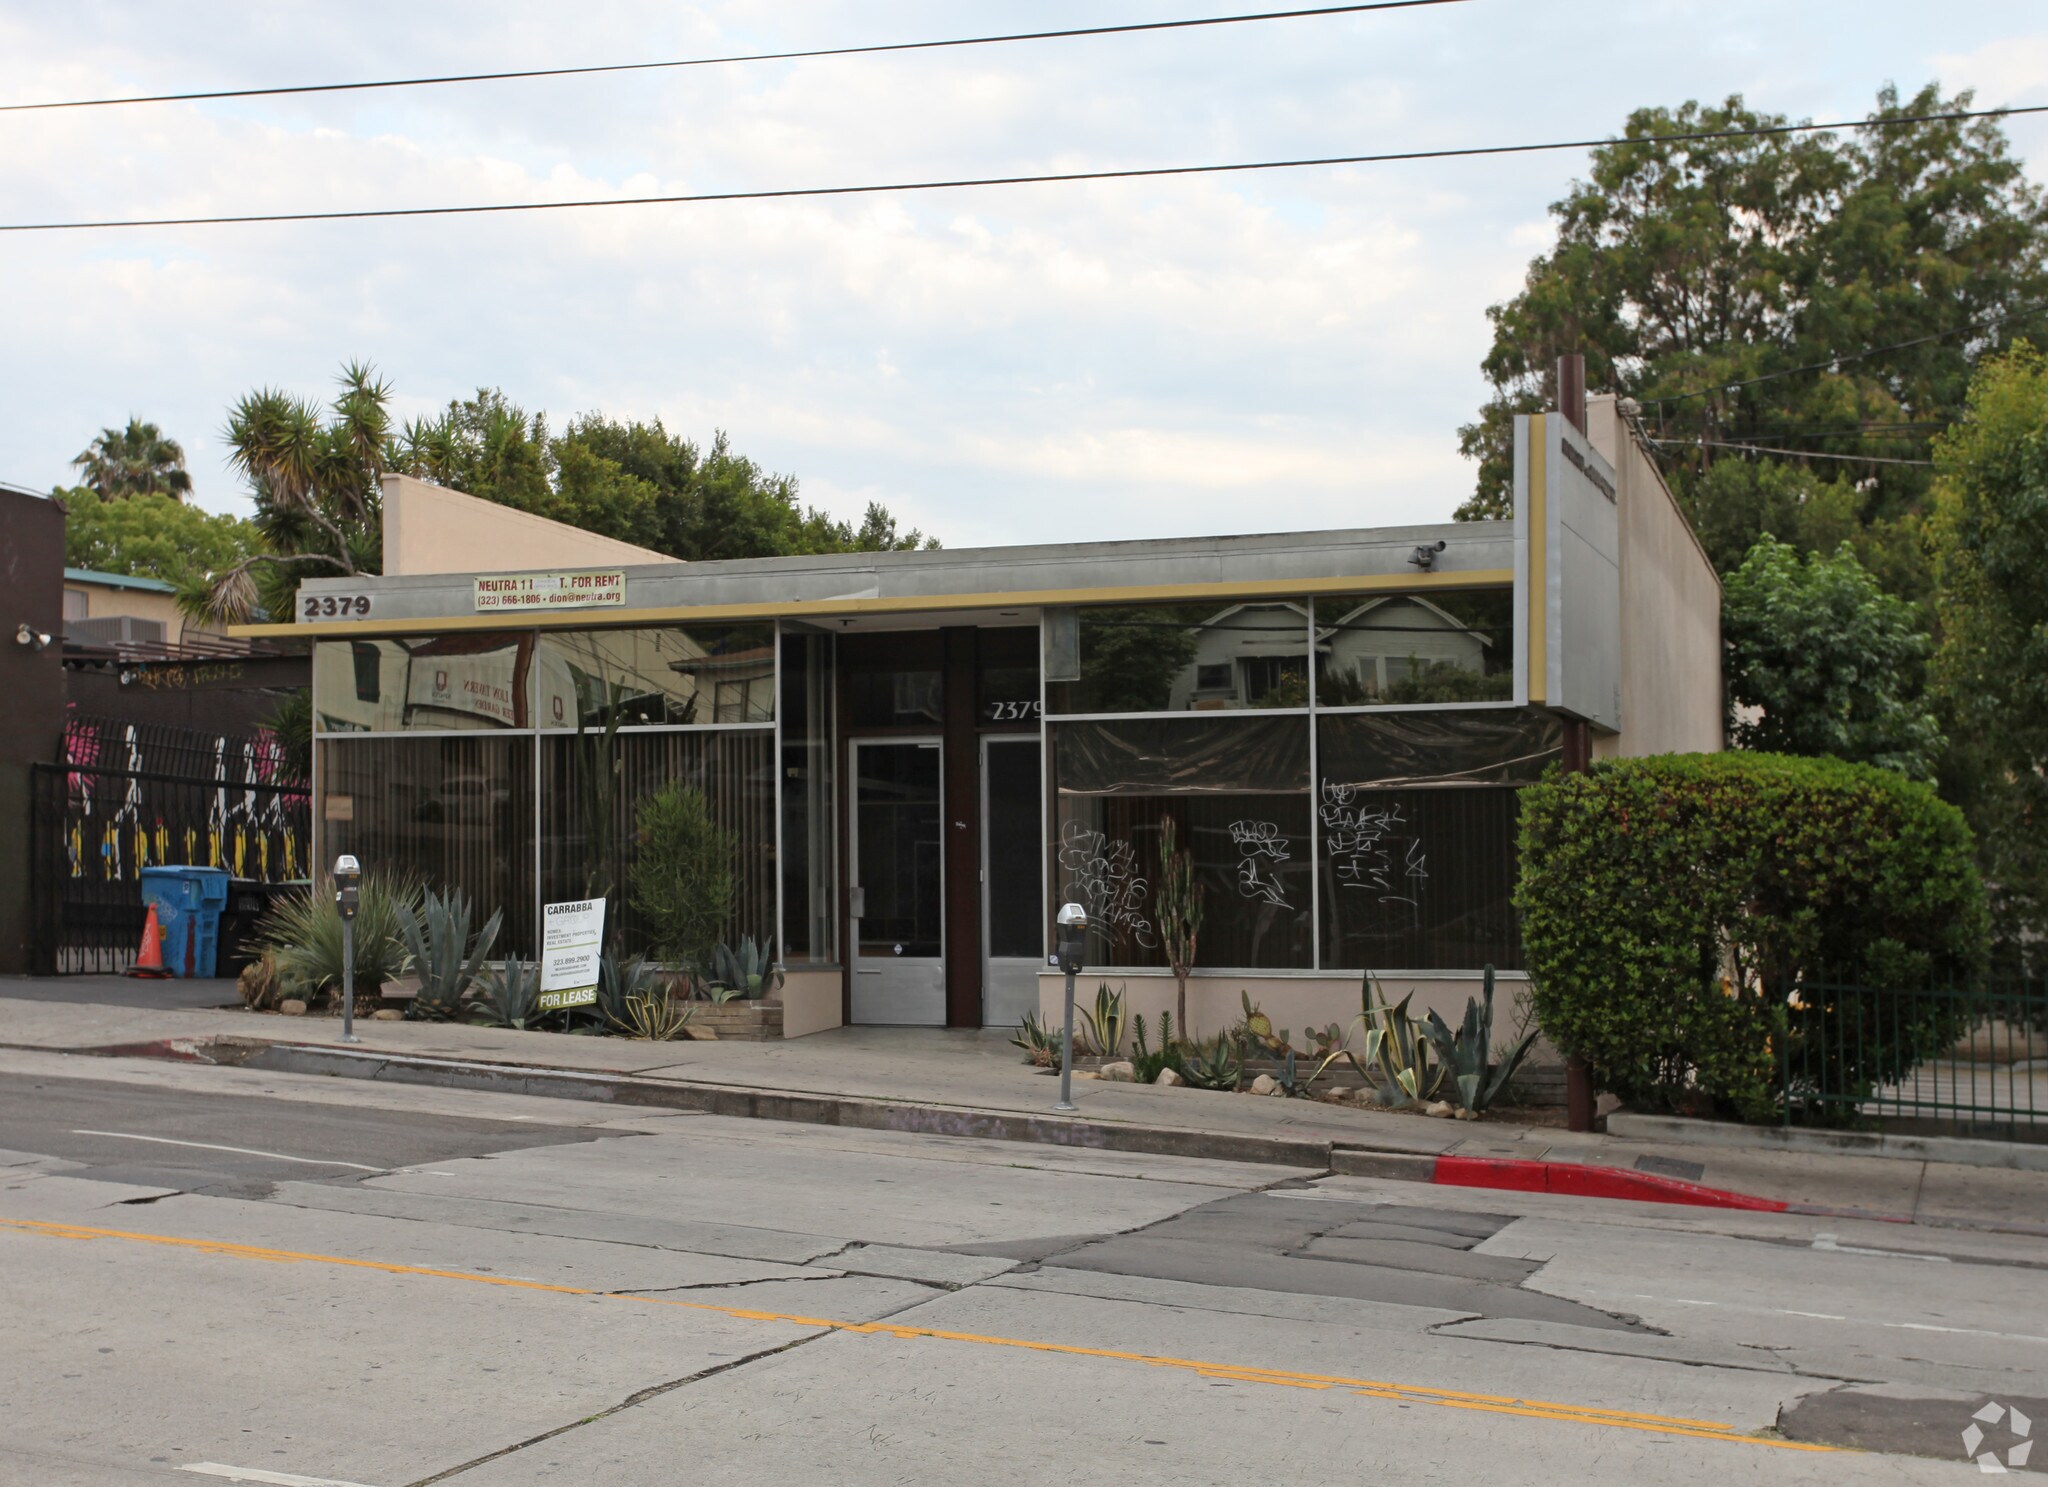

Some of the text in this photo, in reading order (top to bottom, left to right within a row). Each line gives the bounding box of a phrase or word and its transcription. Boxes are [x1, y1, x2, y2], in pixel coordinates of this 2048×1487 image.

[478, 579, 517, 592] NEUTRA
[571, 577, 592, 588] FOR
[595, 574, 621, 587] RENT
[303, 595, 371, 617] 2379
[477, 591, 621, 606] (323) 666-1806 dion@neutra.org
[991, 700, 1041, 720] 2379
[547, 902, 593, 915] CARRABBA
[553, 955, 590, 966] 323.899.2900
[540, 989, 595, 1008] FOR LEASE
